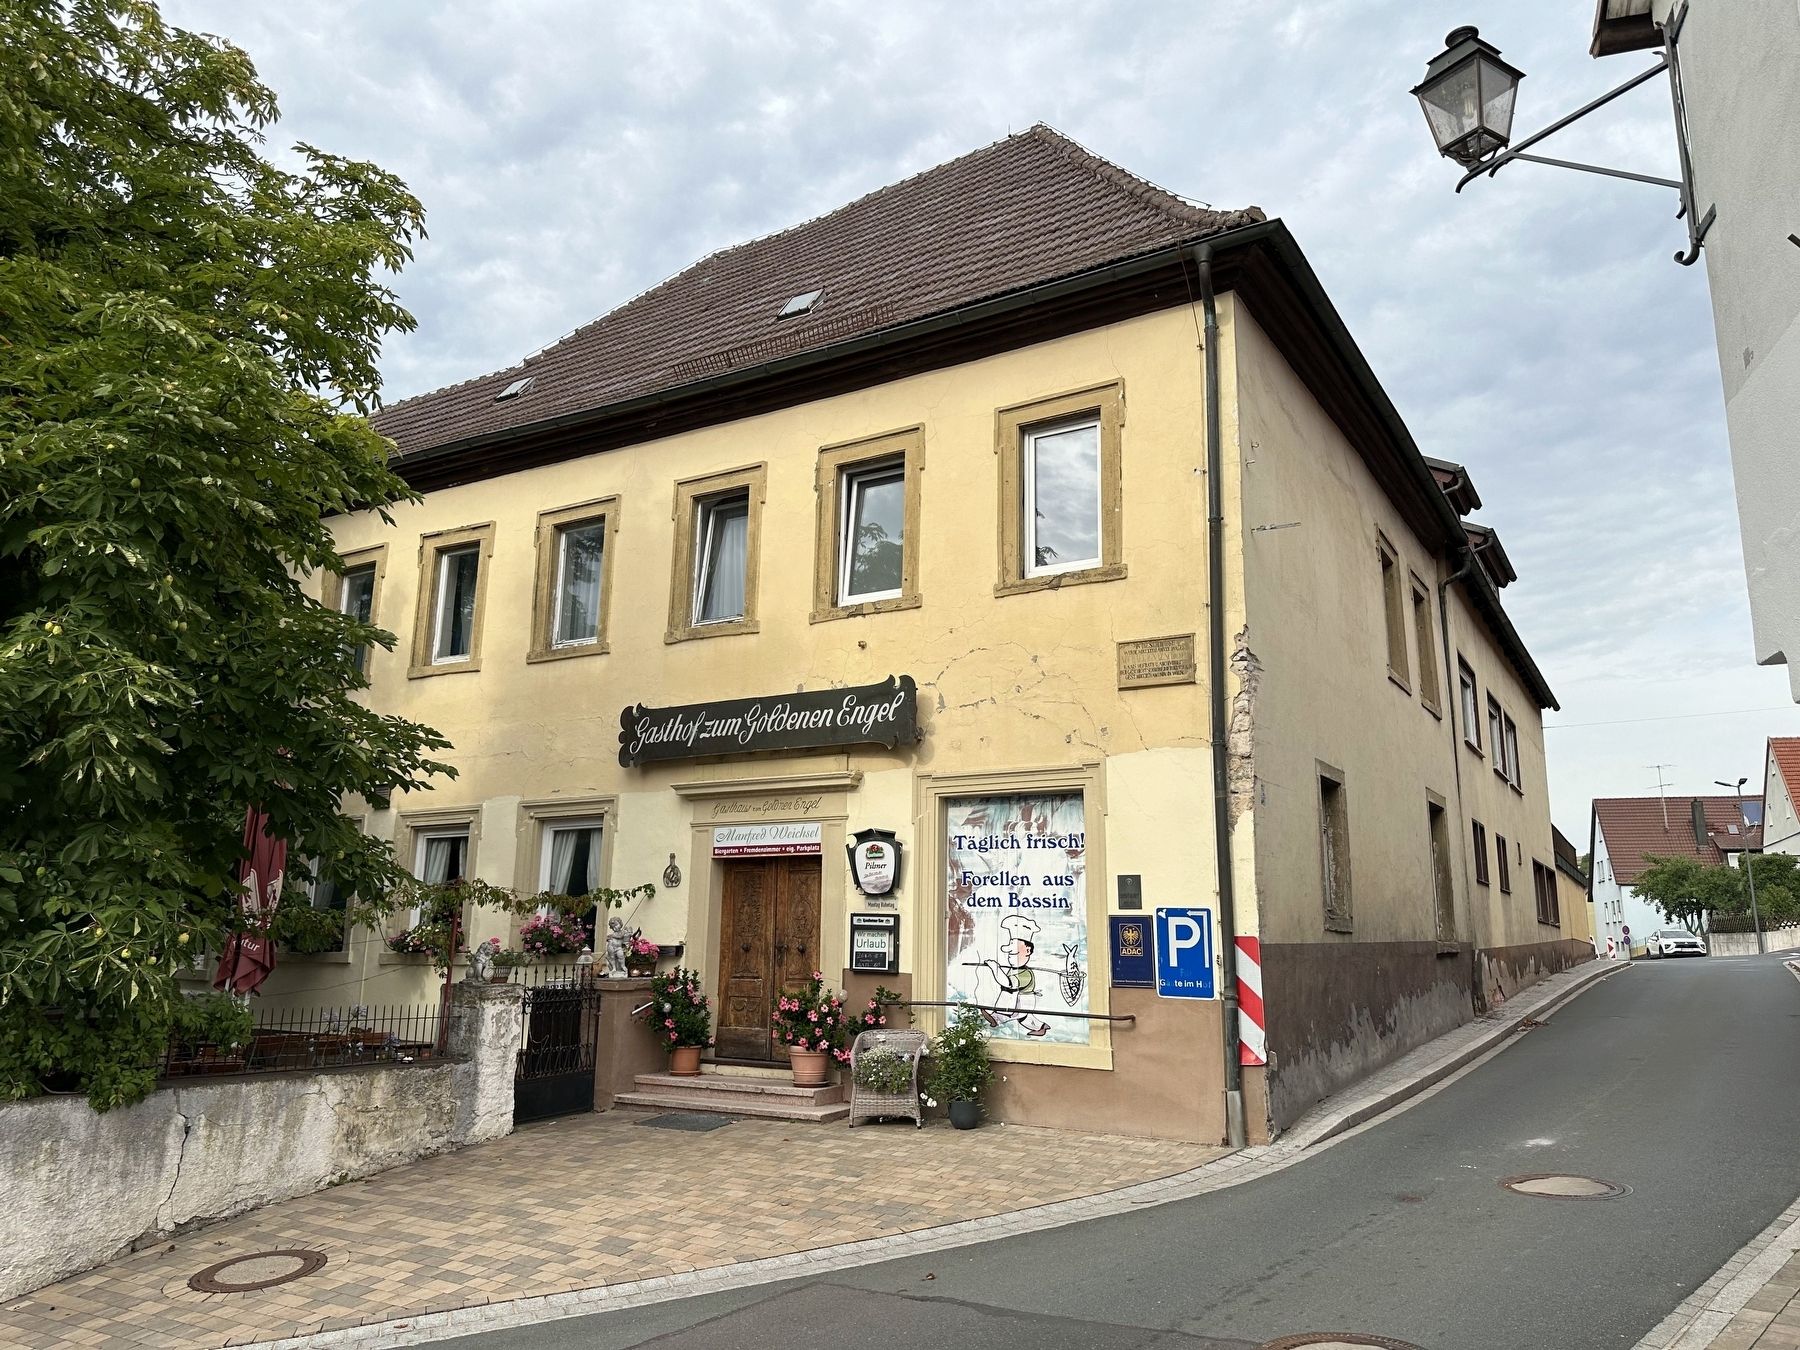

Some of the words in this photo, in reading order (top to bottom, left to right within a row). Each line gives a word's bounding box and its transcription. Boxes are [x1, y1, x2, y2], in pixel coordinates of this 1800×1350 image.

[629, 711, 706, 754] Gasthof
[700, 717, 742, 739] zum
[738, 702, 834, 745] Goldenen
[836, 691, 905, 735] Engel
[793, 797, 823, 815] Engel
[715, 828, 767, 844] Manfred
[769, 825, 820, 840] Weichsel
[953, 834, 1021, 853] Täglich
[1026, 832, 1086, 850] frisch!
[714, 846, 739, 856] Biergarten
[743, 845, 781, 854] Fremdenzimmer
[796, 844, 820, 852] Parkplatz
[961, 871, 1031, 887] Forellen
[1042, 874, 1075, 887] aus
[966, 893, 1002, 908] dem
[1008, 892, 1071, 909] Bassin
[856, 938, 887, 948] Urlaub
[1167, 916, 1201, 968] P
[1184, 979, 1194, 988] im
